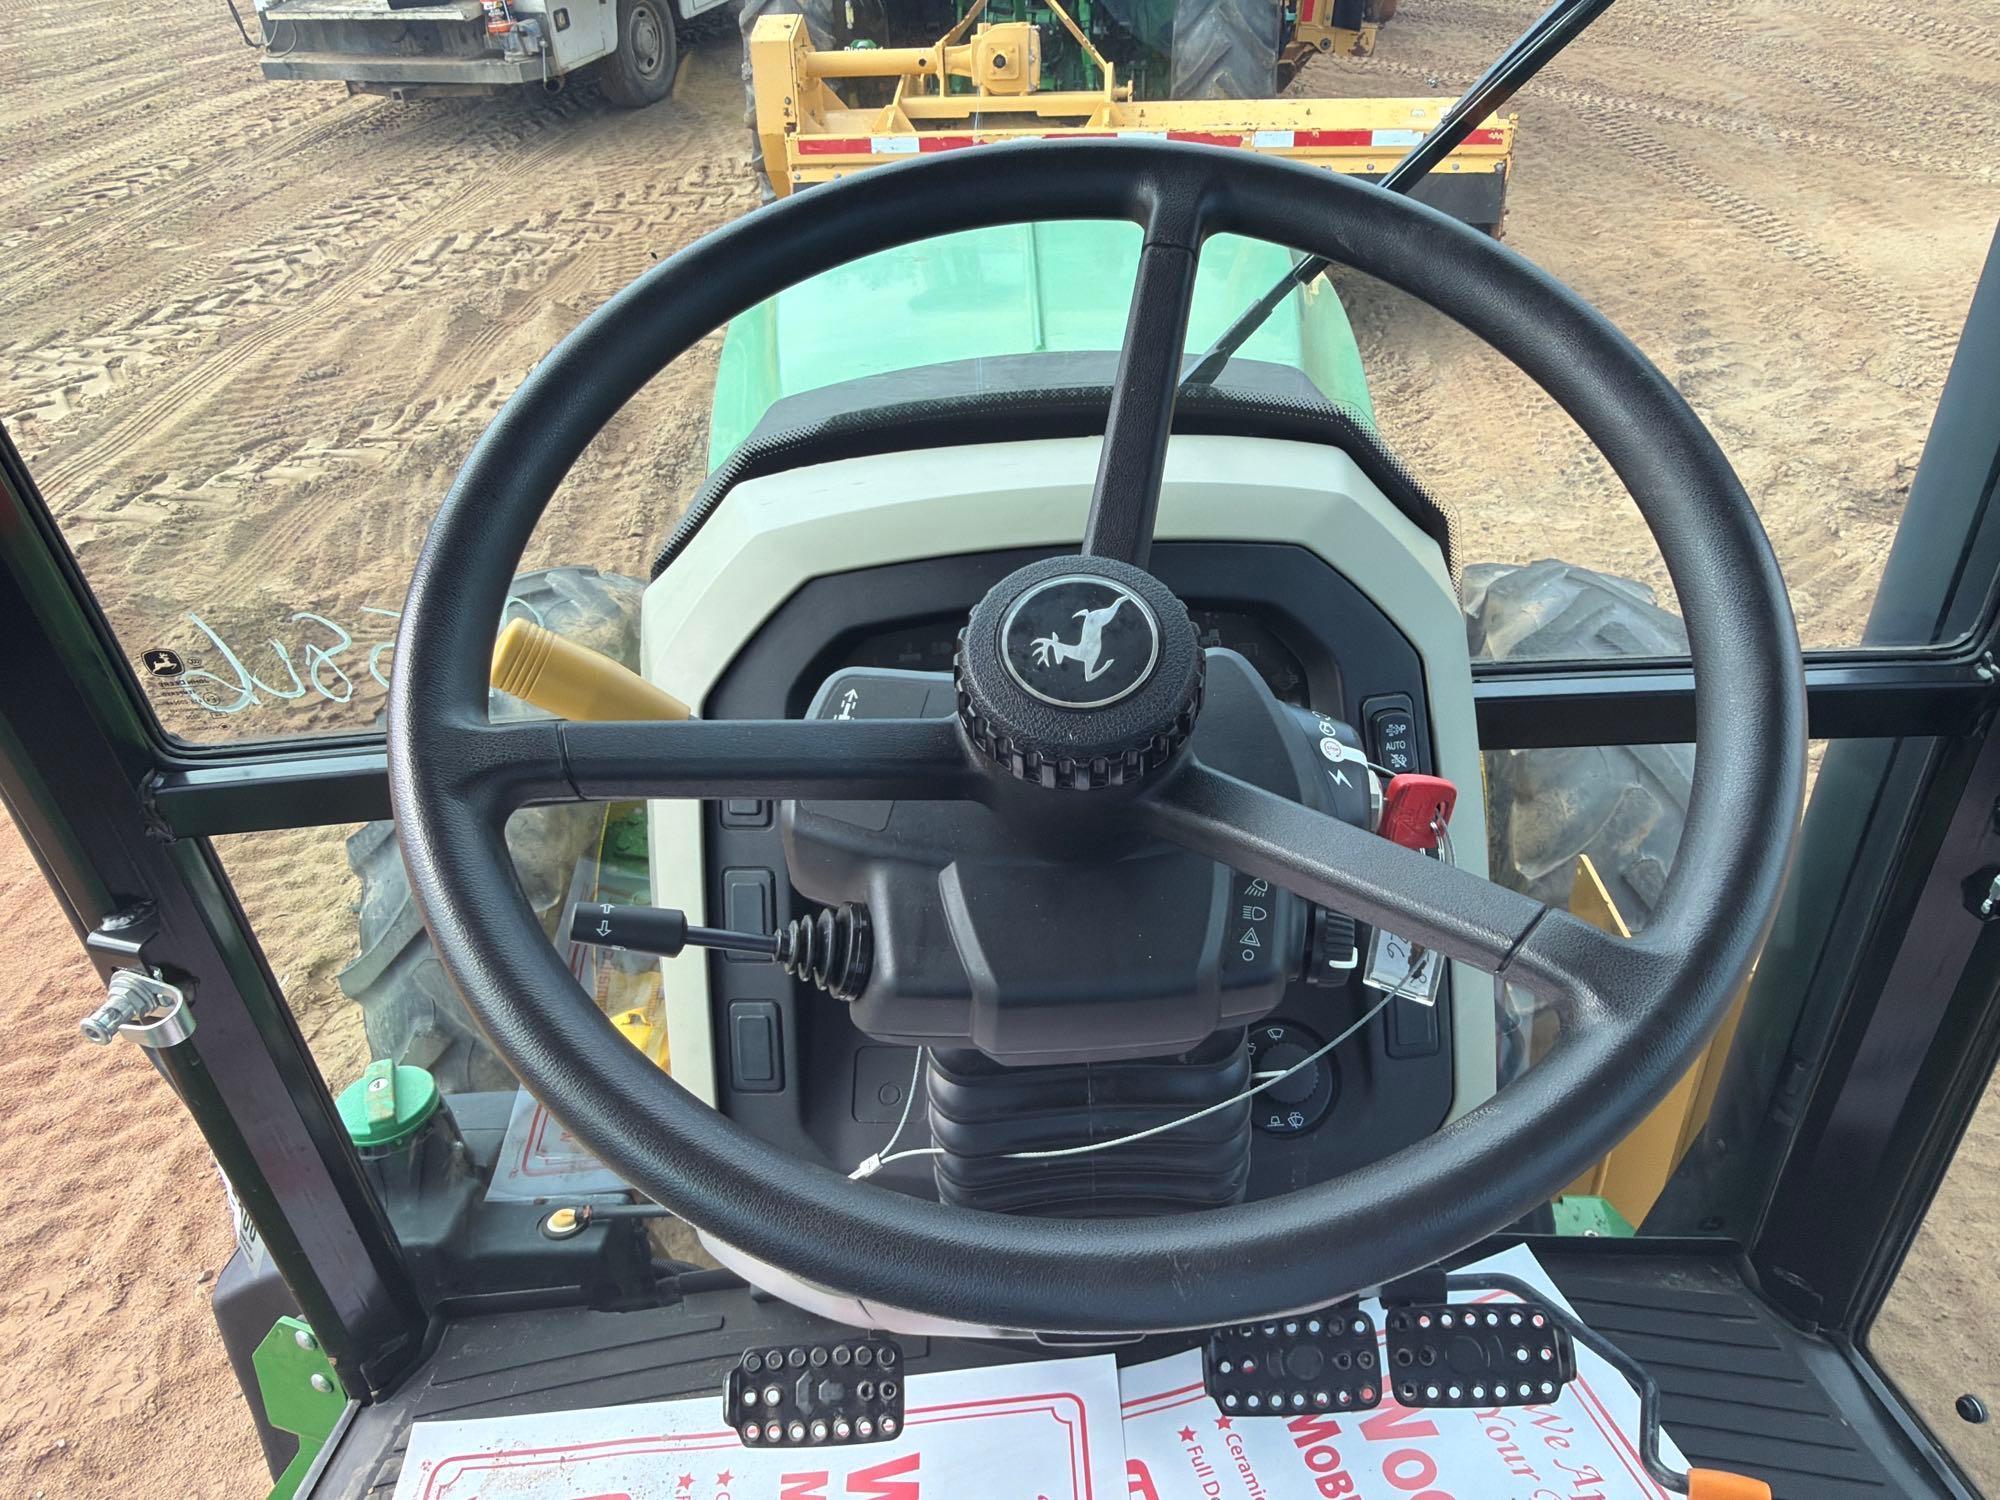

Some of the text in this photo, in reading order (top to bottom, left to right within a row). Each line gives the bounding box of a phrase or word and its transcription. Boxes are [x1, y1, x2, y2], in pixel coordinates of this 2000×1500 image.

[1385, 740, 1406, 751] AUTO
[1473, 1407, 1541, 1482] Your
[1522, 1405, 1574, 1450] We
[1186, 1445, 1214, 1478] Full
